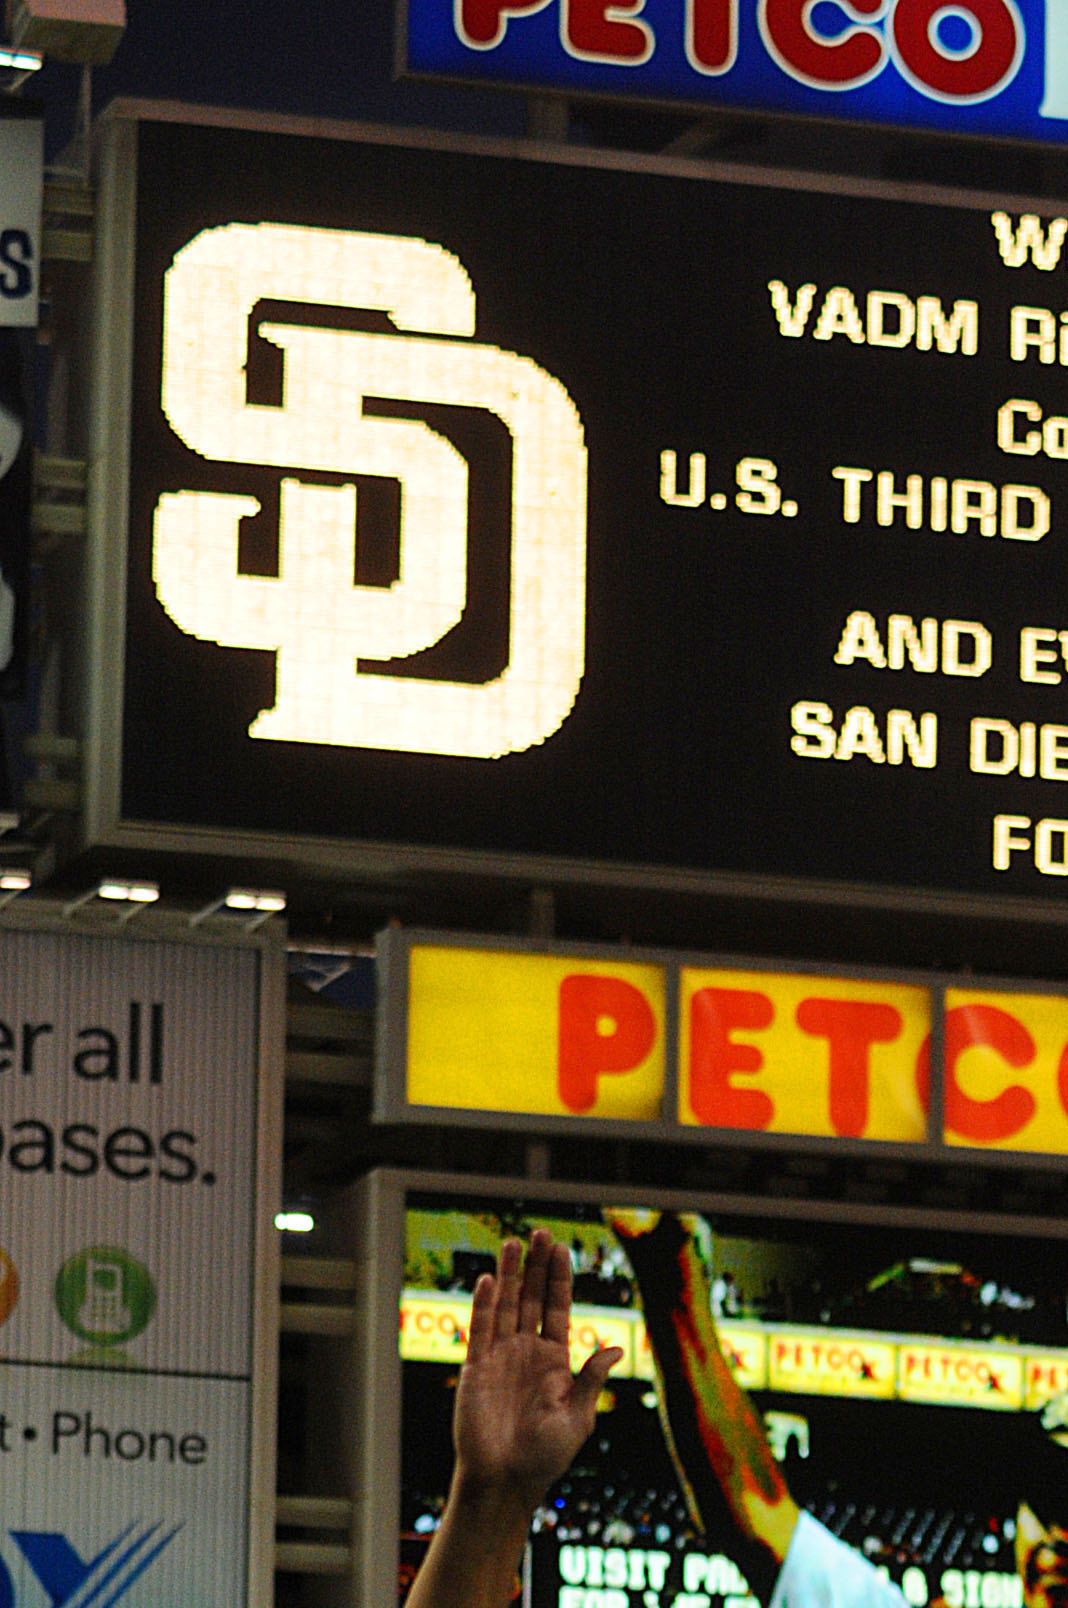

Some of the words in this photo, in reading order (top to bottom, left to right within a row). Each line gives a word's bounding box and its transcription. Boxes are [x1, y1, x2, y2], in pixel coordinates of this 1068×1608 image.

[769, 281, 977, 355] VADM
[660, 450, 798, 517] U.S.
[832, 467, 1050, 542] THIRD
[835, 611, 991, 678] AND
[791, 701, 938, 768] SAN
[0, 1020, 53, 1077] r
[73, 1001, 165, 1085] all
[0, 1119, 216, 1186] ases.
[776, 1340, 864, 1372] PETCO
[906, 1355, 993, 1385] PETCO
[52, 1410, 209, 1466] Phone
